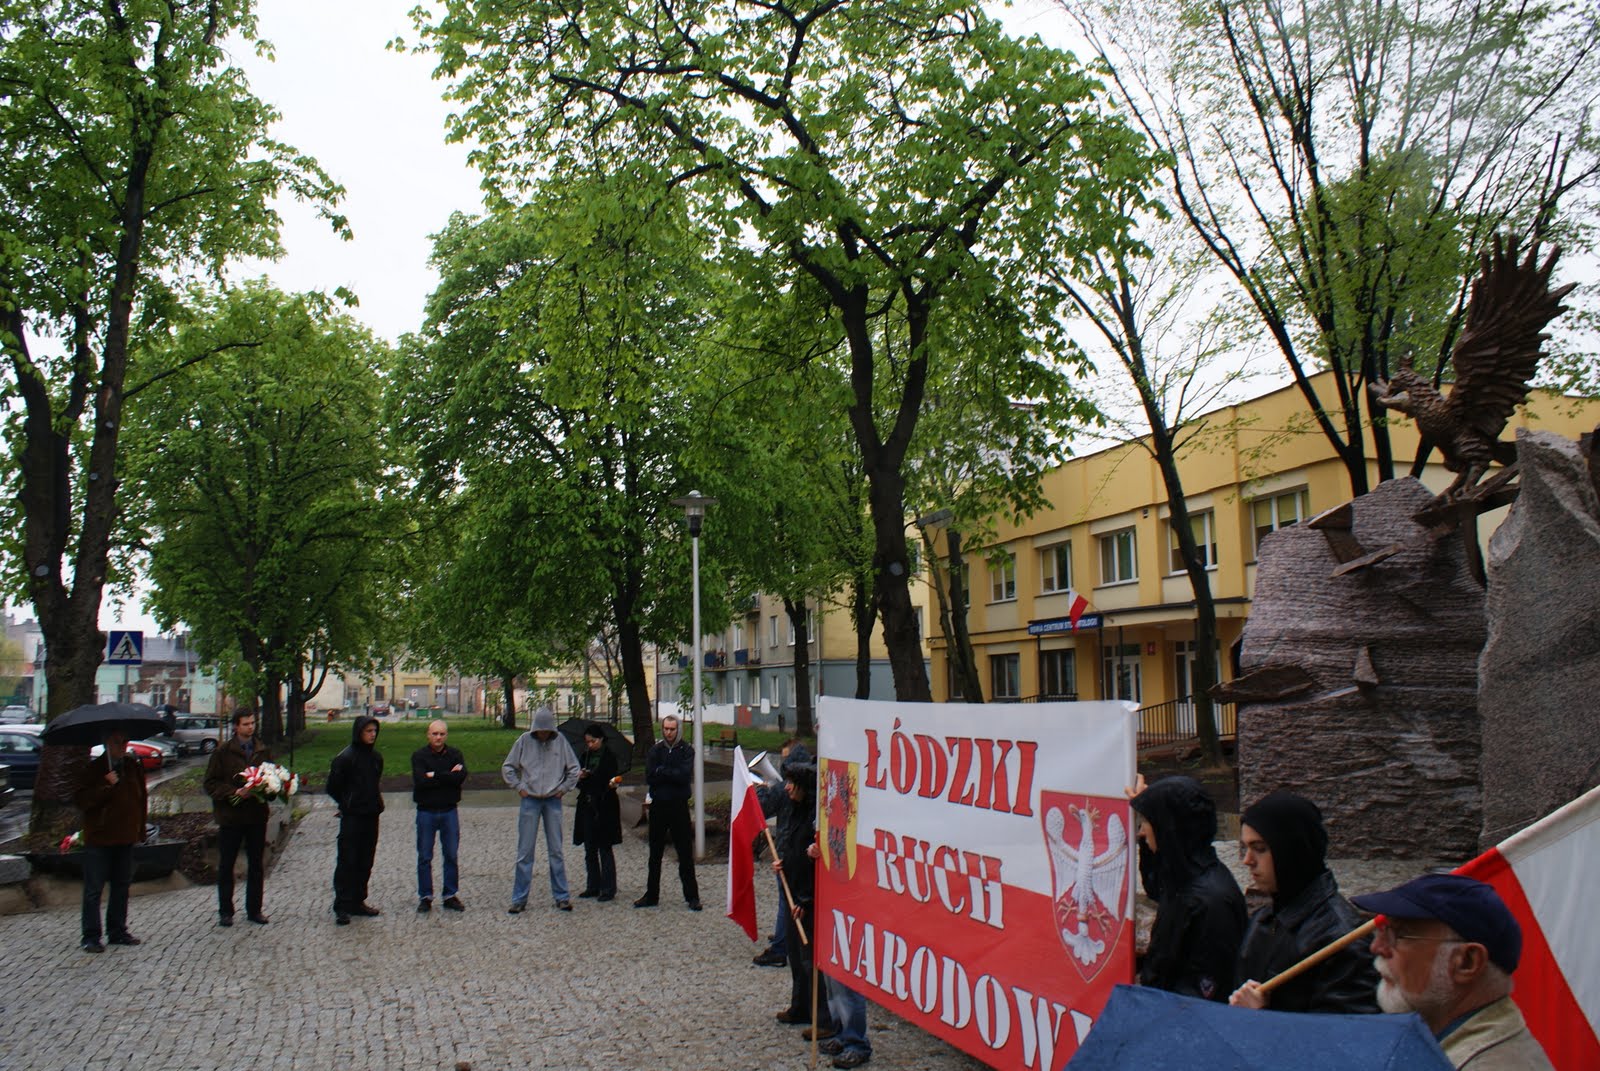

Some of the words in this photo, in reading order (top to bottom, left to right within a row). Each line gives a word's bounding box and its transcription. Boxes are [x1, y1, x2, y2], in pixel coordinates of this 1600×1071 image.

[1044, 623, 1064, 632] CENTRUM
[1064, 617, 1097, 629] STOATOLOGII
[864, 717, 1039, 818] ŁÓDZKI
[874, 828, 1005, 930] RUCH
